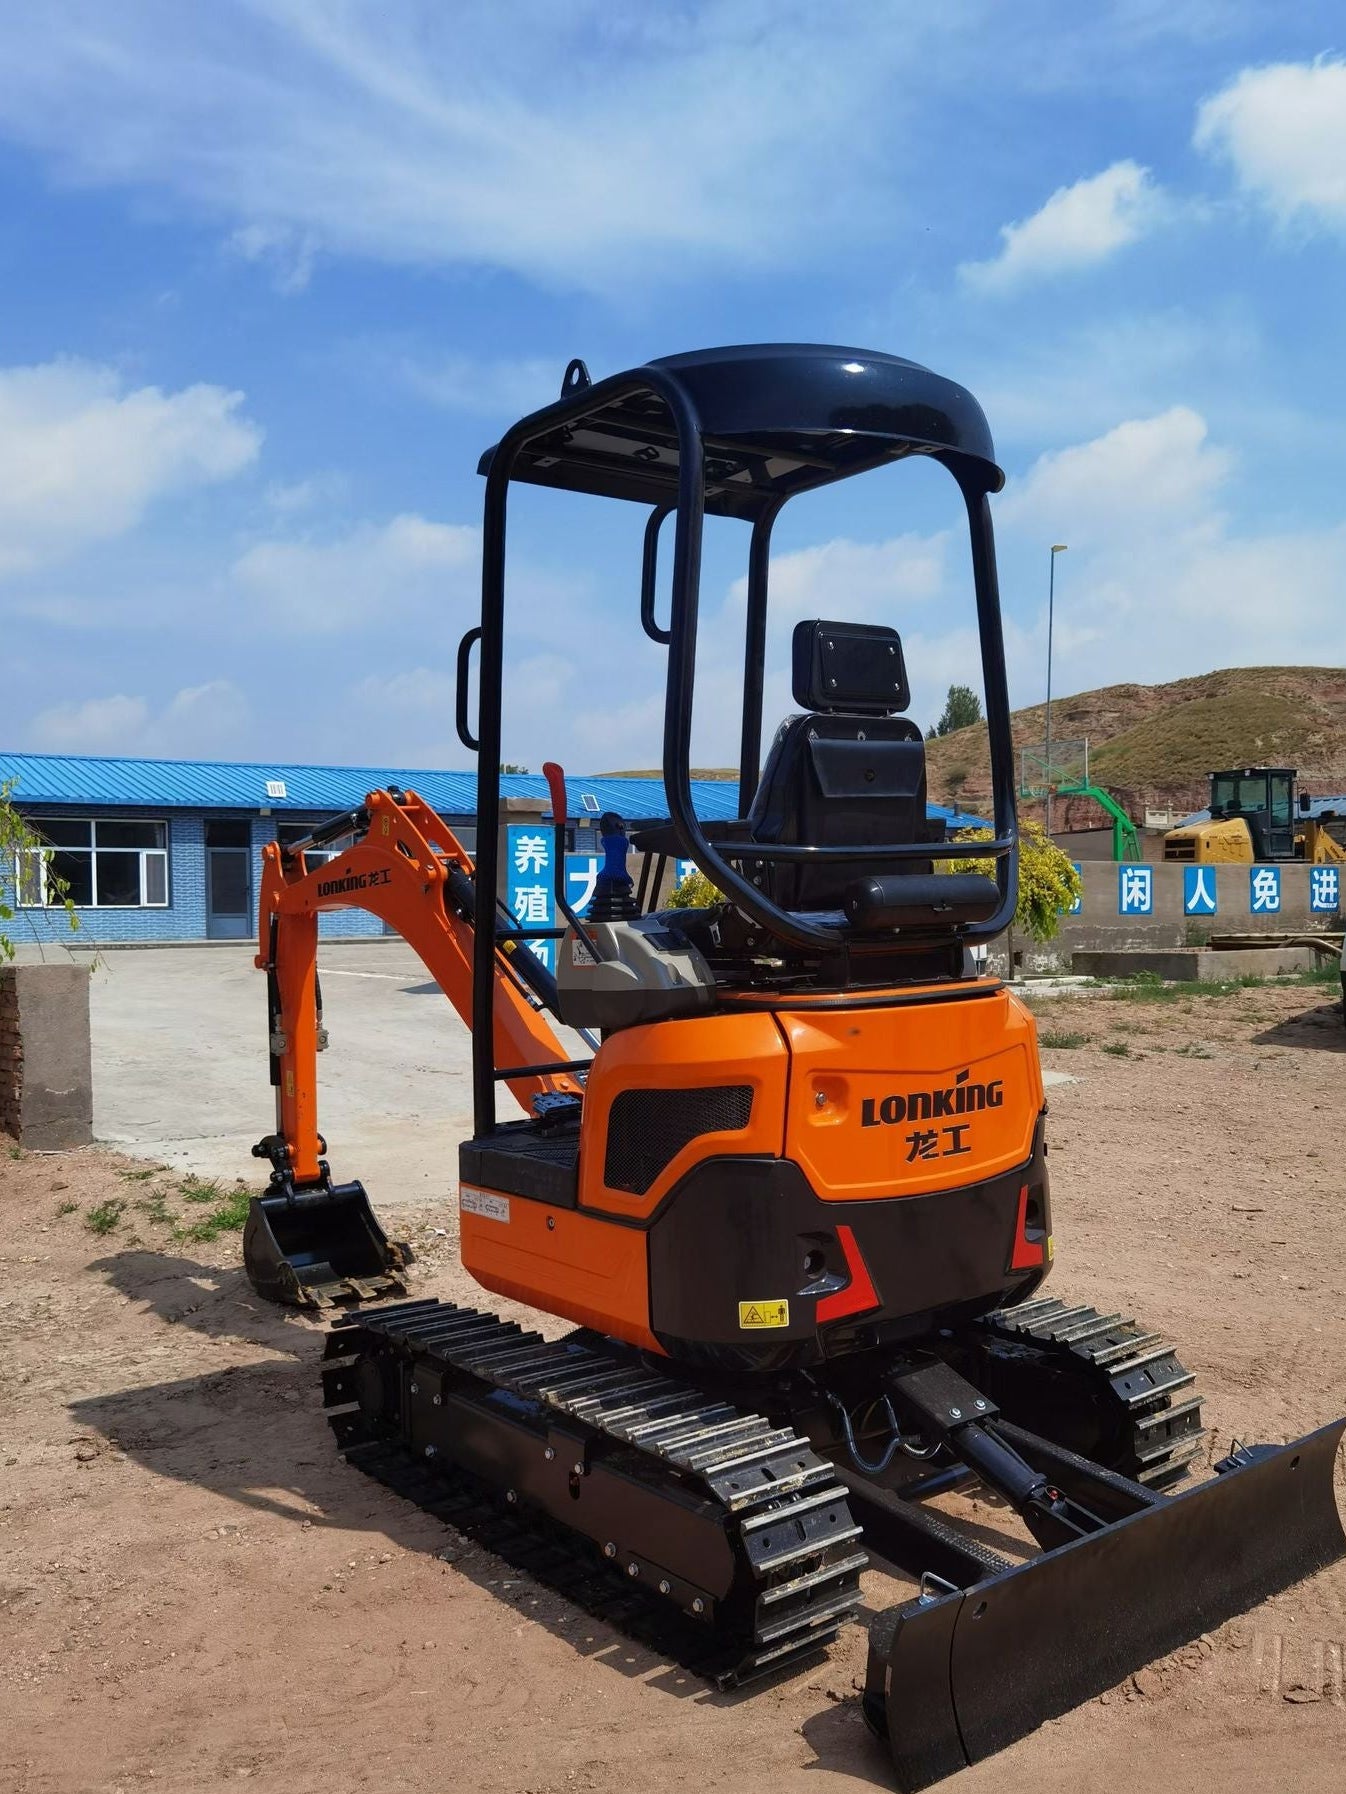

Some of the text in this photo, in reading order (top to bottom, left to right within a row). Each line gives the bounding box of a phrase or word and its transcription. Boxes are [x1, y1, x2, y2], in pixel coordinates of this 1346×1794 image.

[1122, 868, 1337, 911] 闲人免进
[906, 1124, 972, 1163] 龙工
